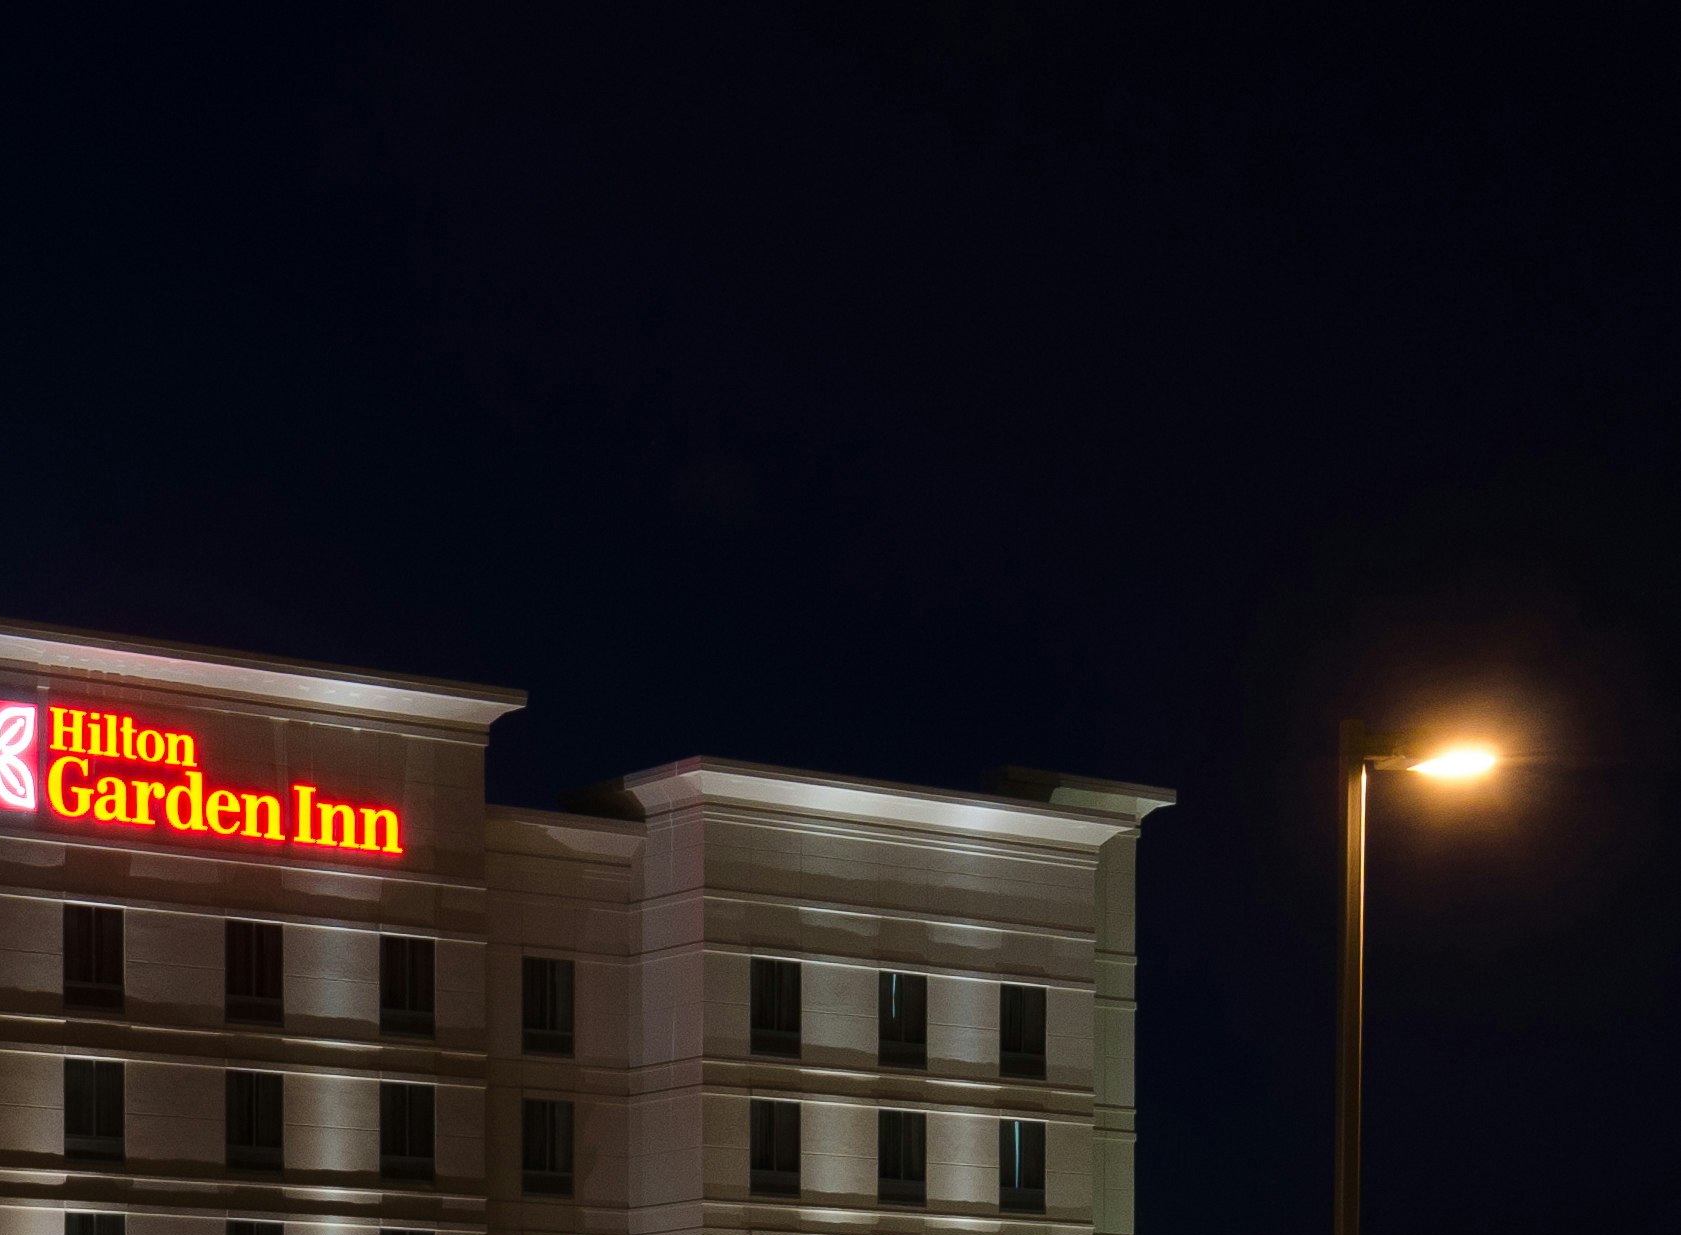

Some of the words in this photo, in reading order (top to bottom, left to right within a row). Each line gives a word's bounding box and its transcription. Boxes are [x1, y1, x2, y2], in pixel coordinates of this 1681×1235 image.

[49, 706, 197, 767] Hilton
[47, 756, 285, 841] Garden
[293, 784, 404, 854] Inn
